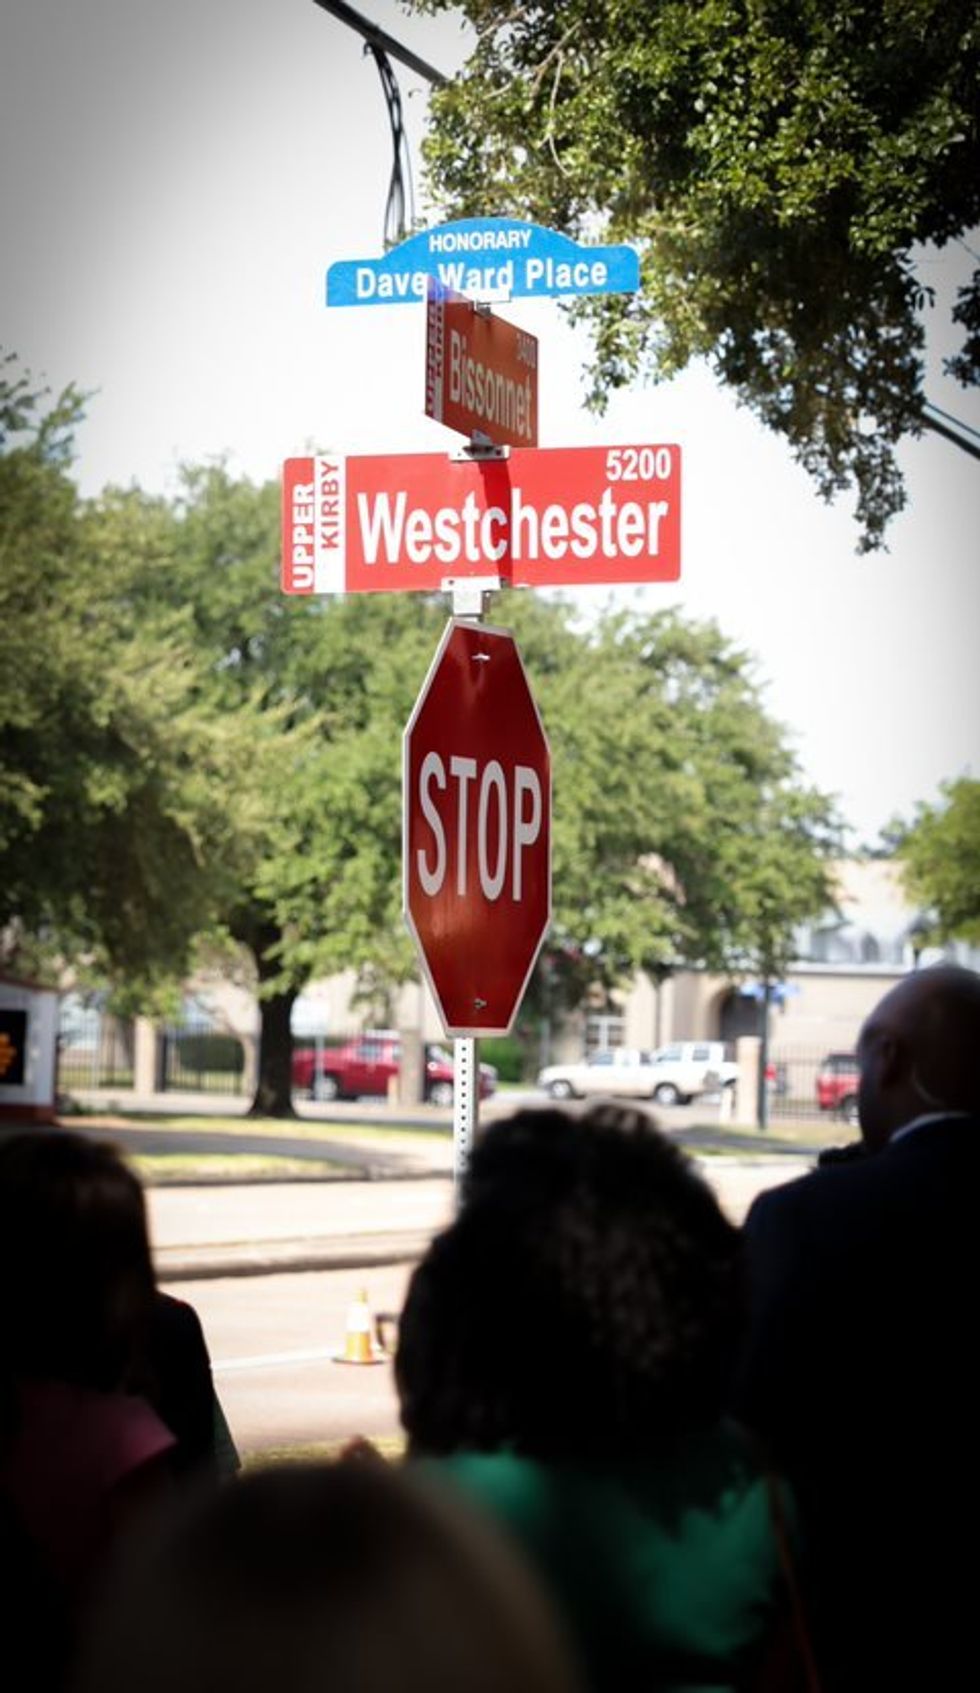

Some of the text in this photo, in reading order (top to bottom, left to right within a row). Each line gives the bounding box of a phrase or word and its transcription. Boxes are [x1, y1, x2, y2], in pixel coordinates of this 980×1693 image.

[356, 257, 607, 298] Dave Ward Place
[429, 228, 533, 252] HONORARY
[451, 328, 532, 440] Bissonnet
[320, 460, 340, 550] KIRBY
[606, 448, 672, 481] 5200
[292, 482, 315, 588] UPPER
[357, 487, 669, 565] Westchester
[416, 751, 542, 902] STOP
